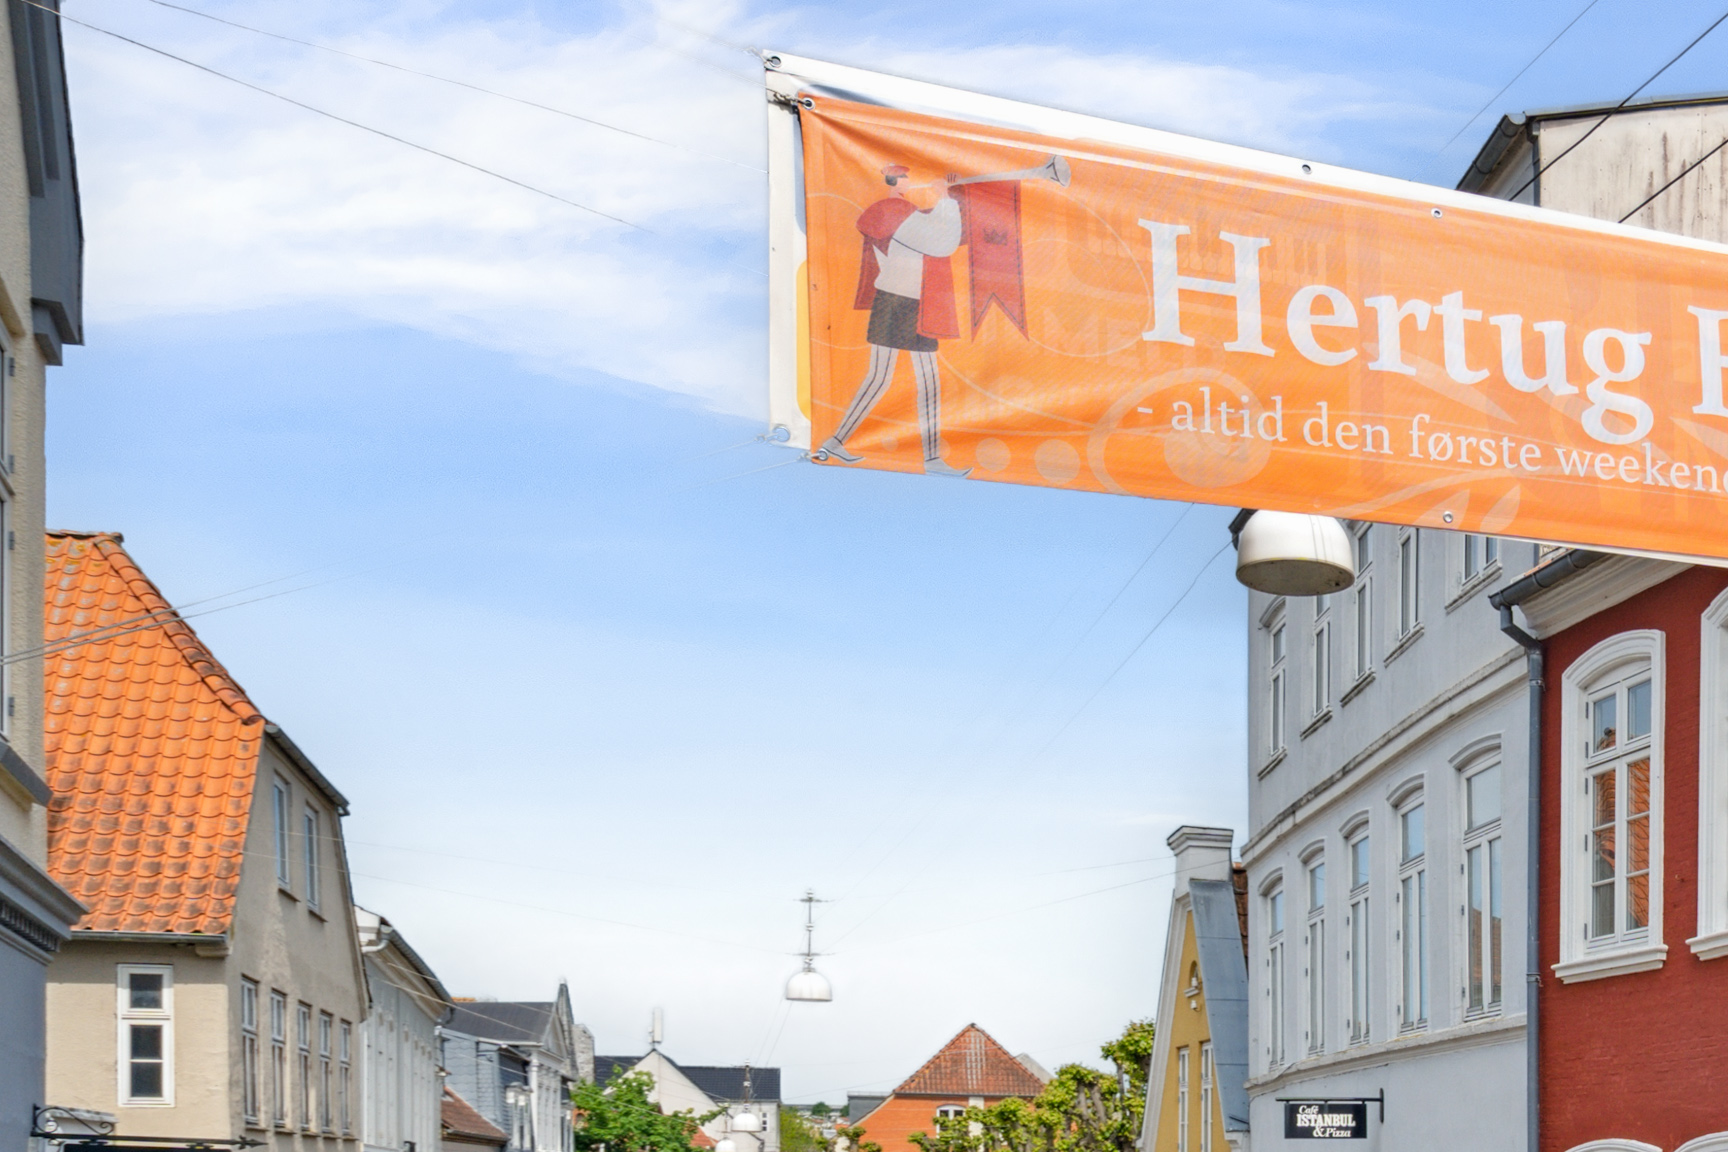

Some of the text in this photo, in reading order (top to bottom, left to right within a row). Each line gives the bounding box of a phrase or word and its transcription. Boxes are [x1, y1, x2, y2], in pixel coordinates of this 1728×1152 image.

[1137, 218, 1653, 445] Hertug
[1171, 386, 1288, 443] altid
[1302, 402, 1394, 455] den
[1408, 414, 1543, 472] første
[1299, 1105, 1319, 1115] Café
[1296, 1113, 1356, 1127] ISTANBUL
[1325, 1127, 1352, 1138] Pizza
